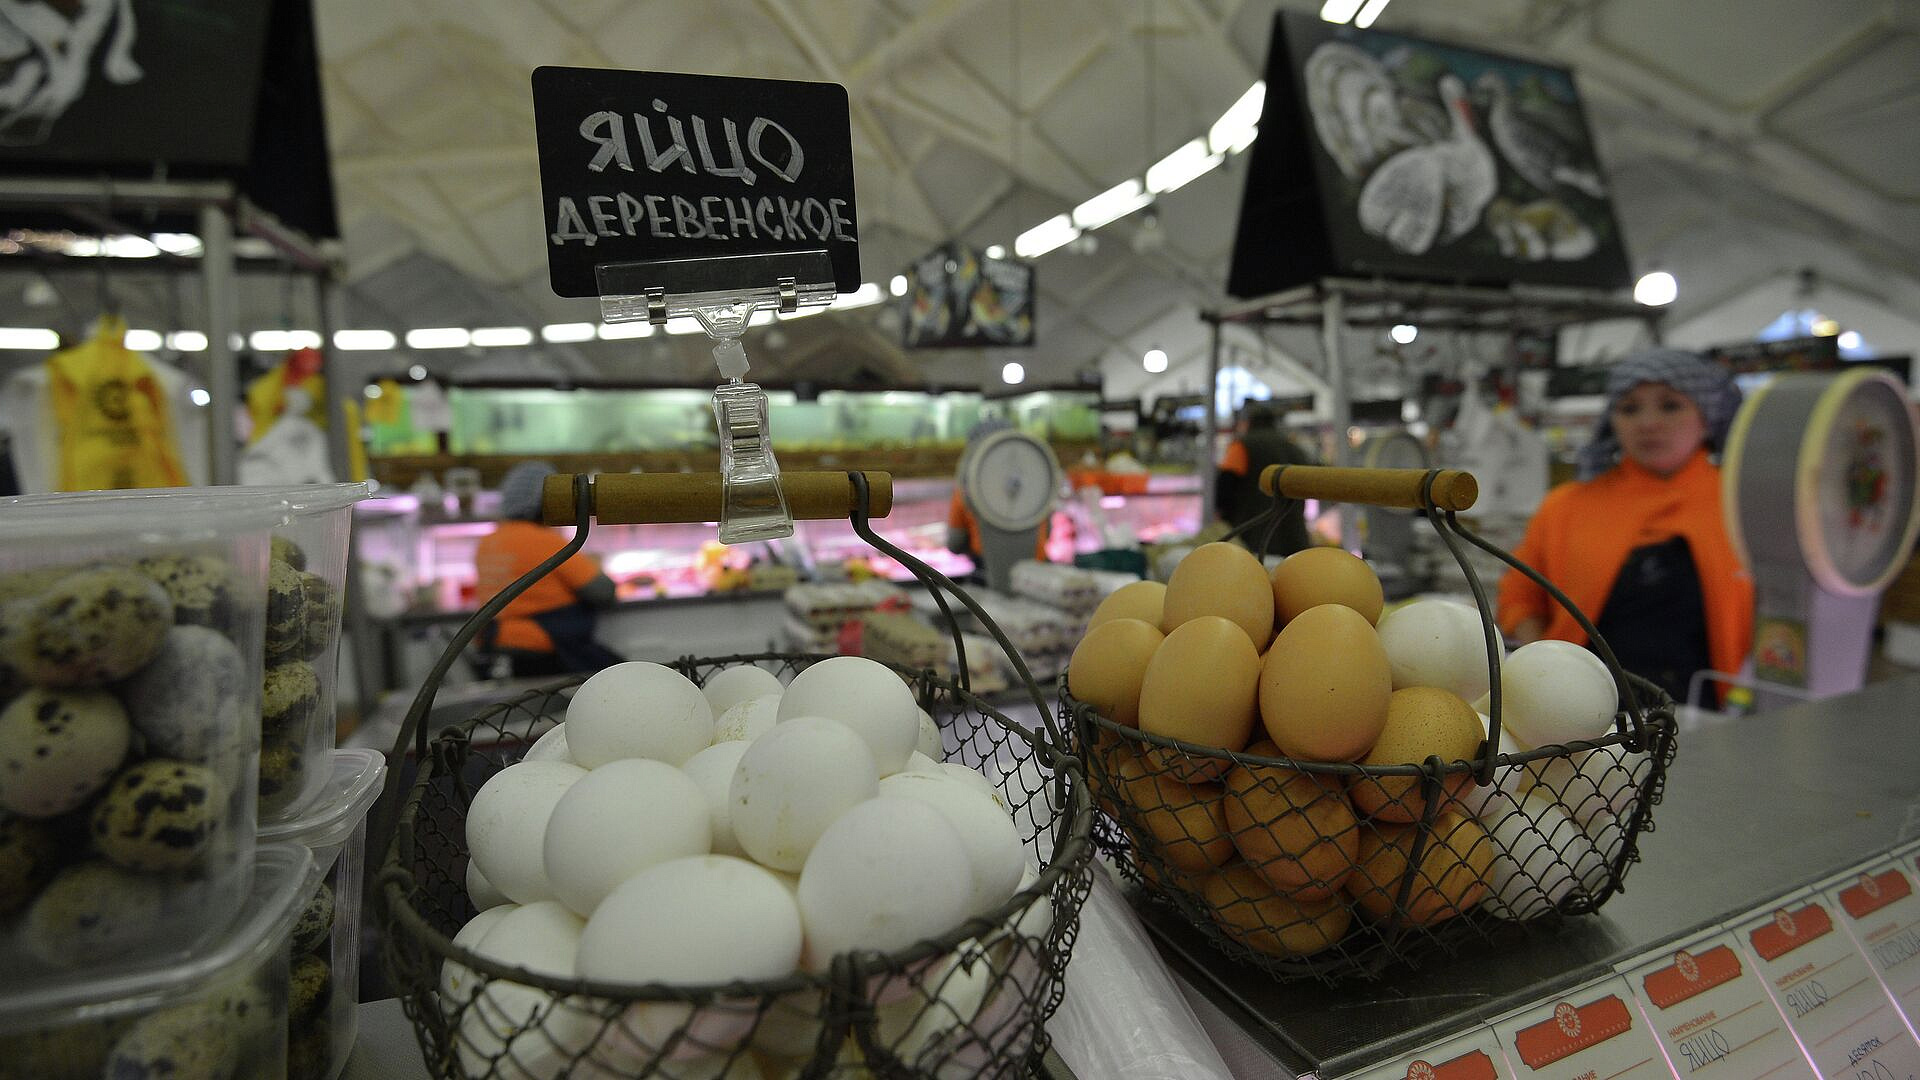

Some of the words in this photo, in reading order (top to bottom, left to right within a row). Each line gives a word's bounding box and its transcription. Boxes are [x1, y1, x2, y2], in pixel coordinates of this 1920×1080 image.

[579, 98, 805, 186] ЯЙЦО
[550, 191, 857, 247] ДЕРЕВЕНСКОЕ
[1786, 980, 1828, 1018] ЯЙЦО
[1679, 1028, 1730, 1073] ЯЙЦО
